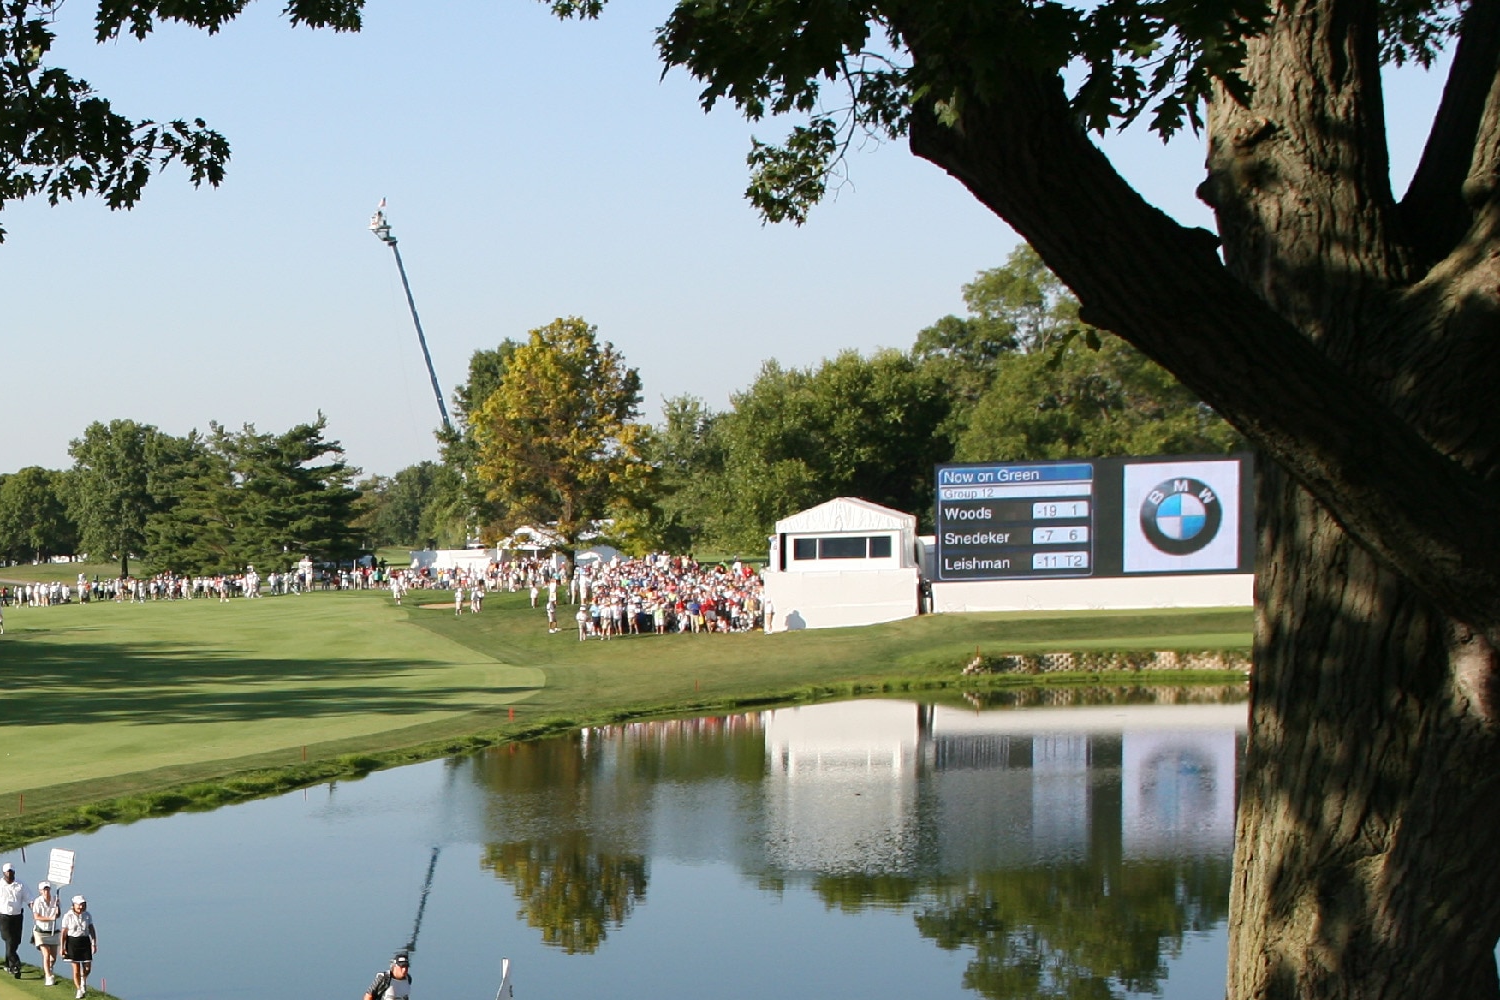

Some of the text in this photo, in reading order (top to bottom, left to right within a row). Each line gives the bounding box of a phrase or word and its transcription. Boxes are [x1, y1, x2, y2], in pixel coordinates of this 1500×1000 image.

[943, 469, 1040, 484] Now on Green
[943, 488, 994, 500] Group 12
[1148, 479, 1215, 505] BMW
[944, 504, 1077, 521] Woods -19 1
[944, 529, 1079, 545] Snedeker -7 6
[944, 554, 1083, 571] Leishman -11 T2
